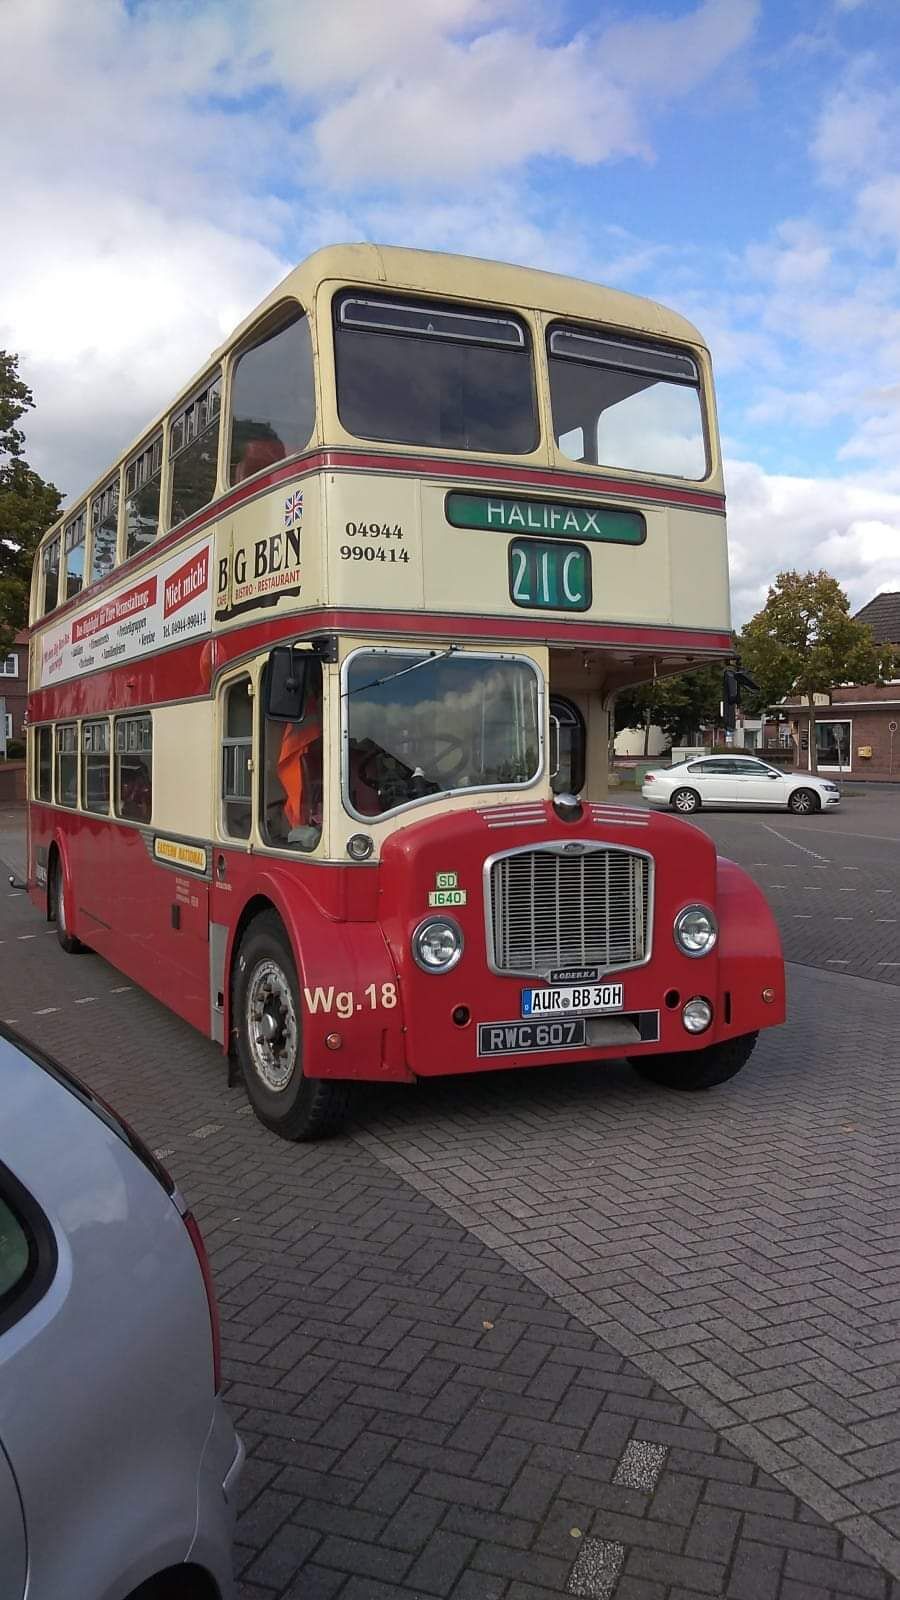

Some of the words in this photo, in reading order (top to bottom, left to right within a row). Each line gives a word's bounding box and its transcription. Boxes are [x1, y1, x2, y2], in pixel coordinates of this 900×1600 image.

[345, 521, 404, 540] 04944
[487, 502, 601, 534] HALIFAX
[253, 526, 302, 579] BEN
[339, 544, 410, 564] 990414
[165, 578, 182, 610] Miet
[183, 560, 206, 597] mich!
[235, 584, 253, 600] BISTRO
[257, 569, 301, 593] RESTAURANT
[512, 548, 583, 603] 21C
[439, 875, 455, 887] SD
[434, 892, 462, 905] 1640
[303, 982, 398, 1019] Wg.18
[533, 990, 561, 1011] AUR
[490, 1028, 532, 1050] RWC
[536, 1022, 577, 1046] 607
